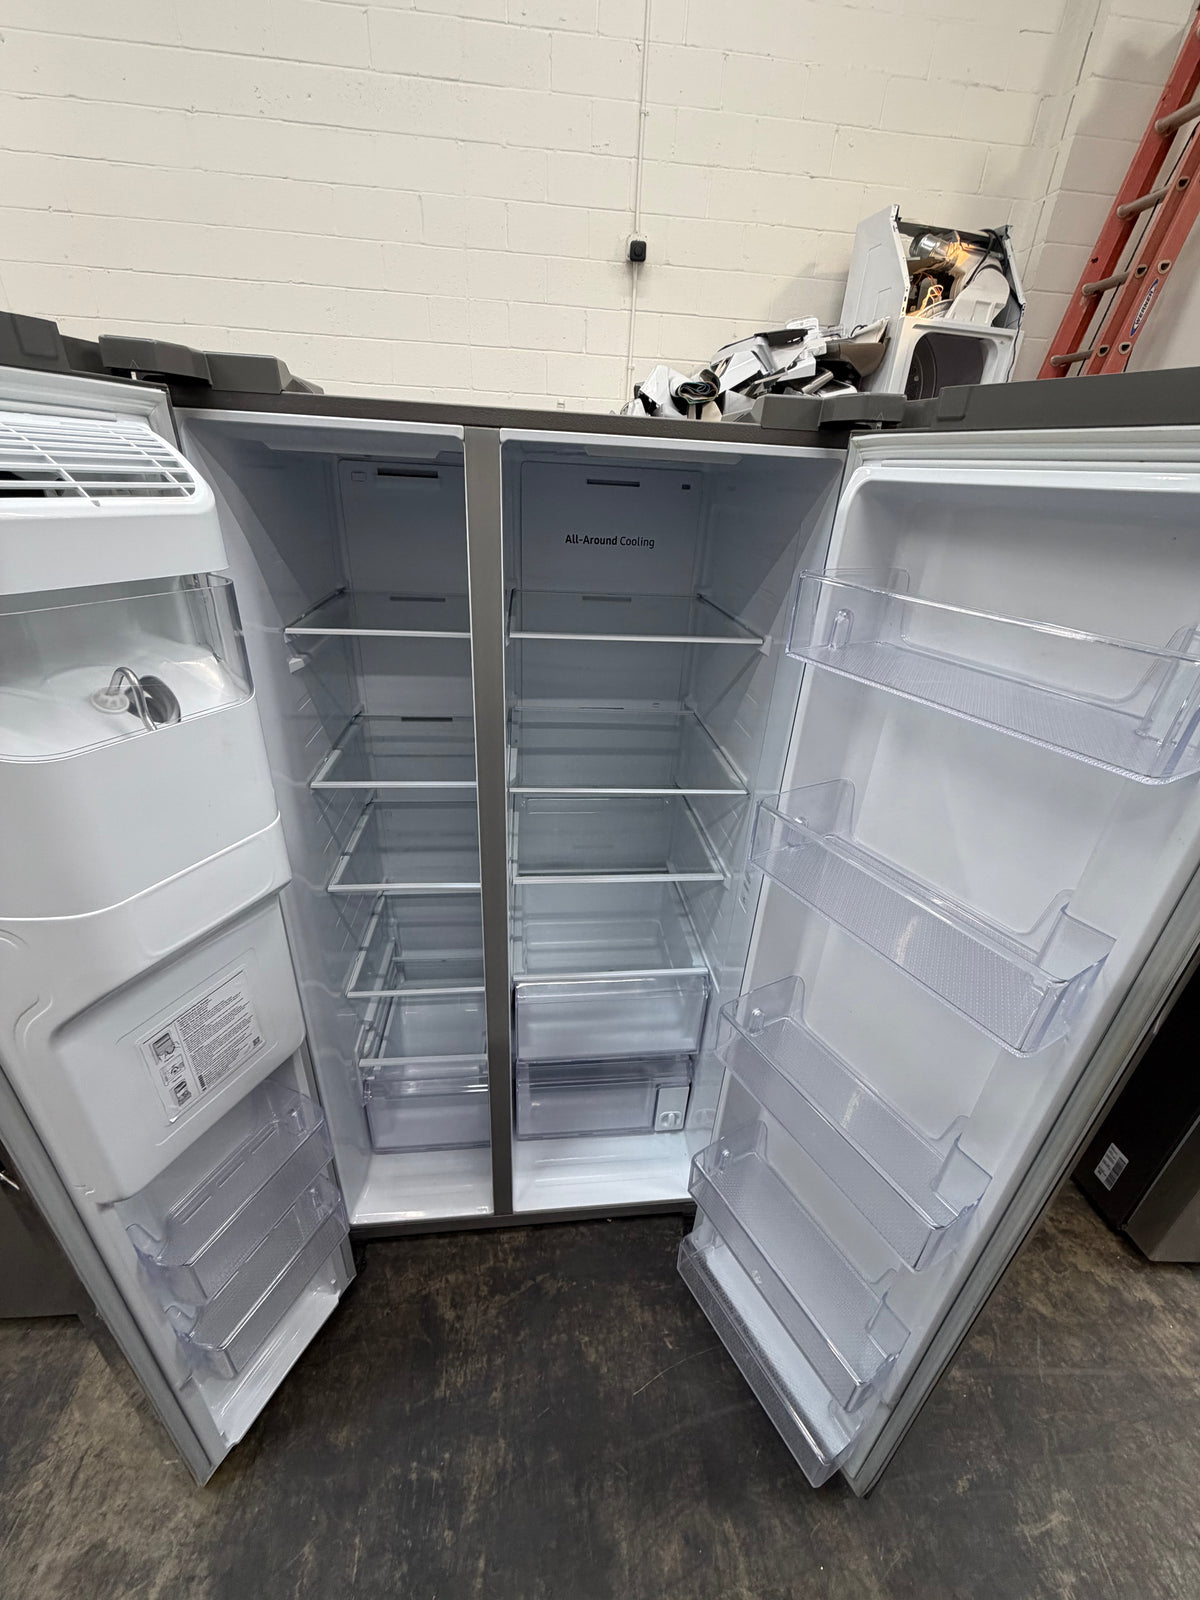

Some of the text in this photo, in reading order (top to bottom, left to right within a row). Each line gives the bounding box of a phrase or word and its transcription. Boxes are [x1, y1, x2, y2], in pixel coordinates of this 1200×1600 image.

[1135, 290, 1154, 325] WERNER
[565, 534, 655, 550] All-Around Cooling
